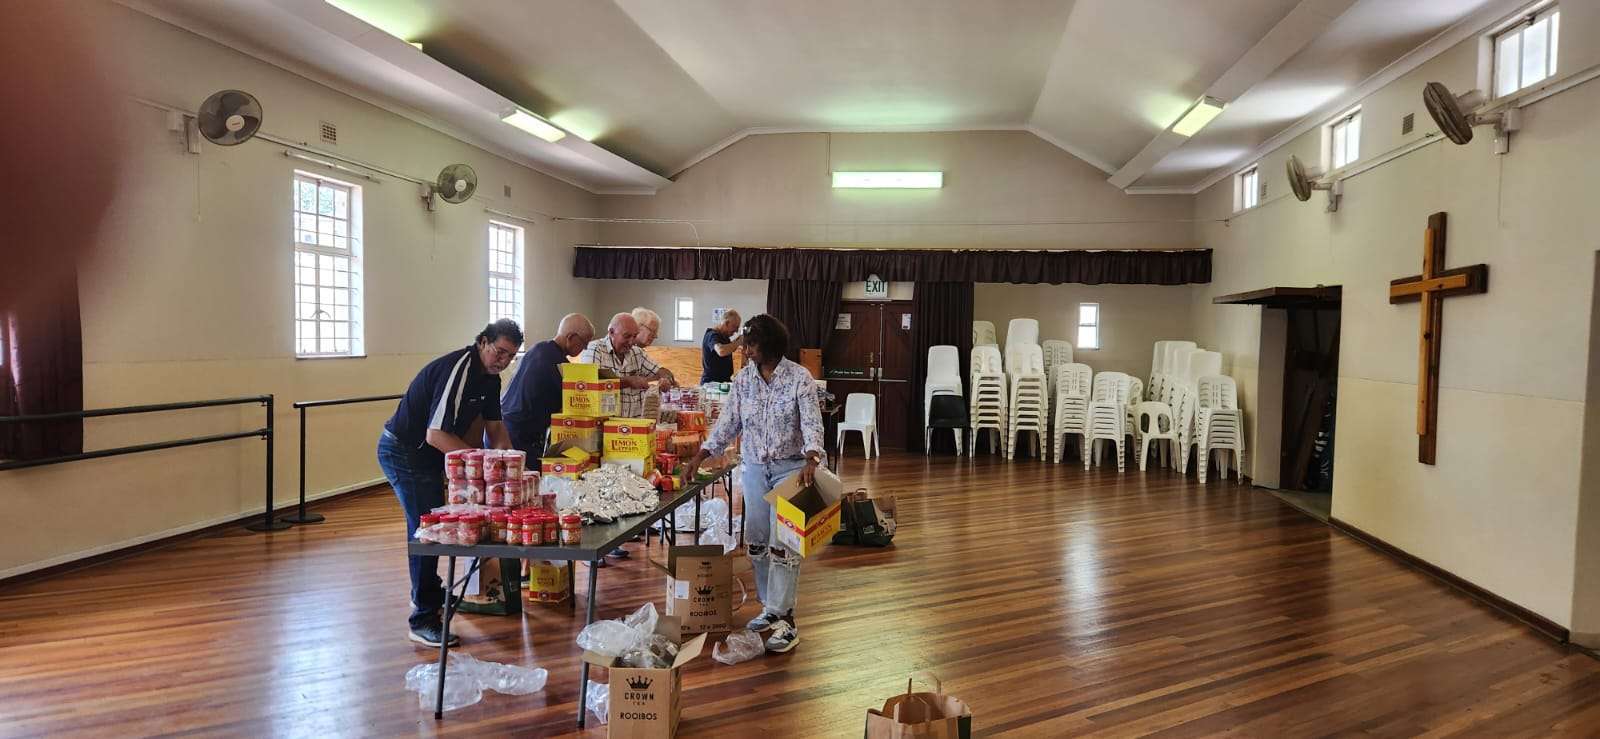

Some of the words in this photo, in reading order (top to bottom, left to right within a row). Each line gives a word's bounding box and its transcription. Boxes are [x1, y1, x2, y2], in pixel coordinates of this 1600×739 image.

[865, 281, 886, 293] EXIT
[624, 692, 654, 700] CROWN
[620, 711, 657, 720] ROOIBOS
